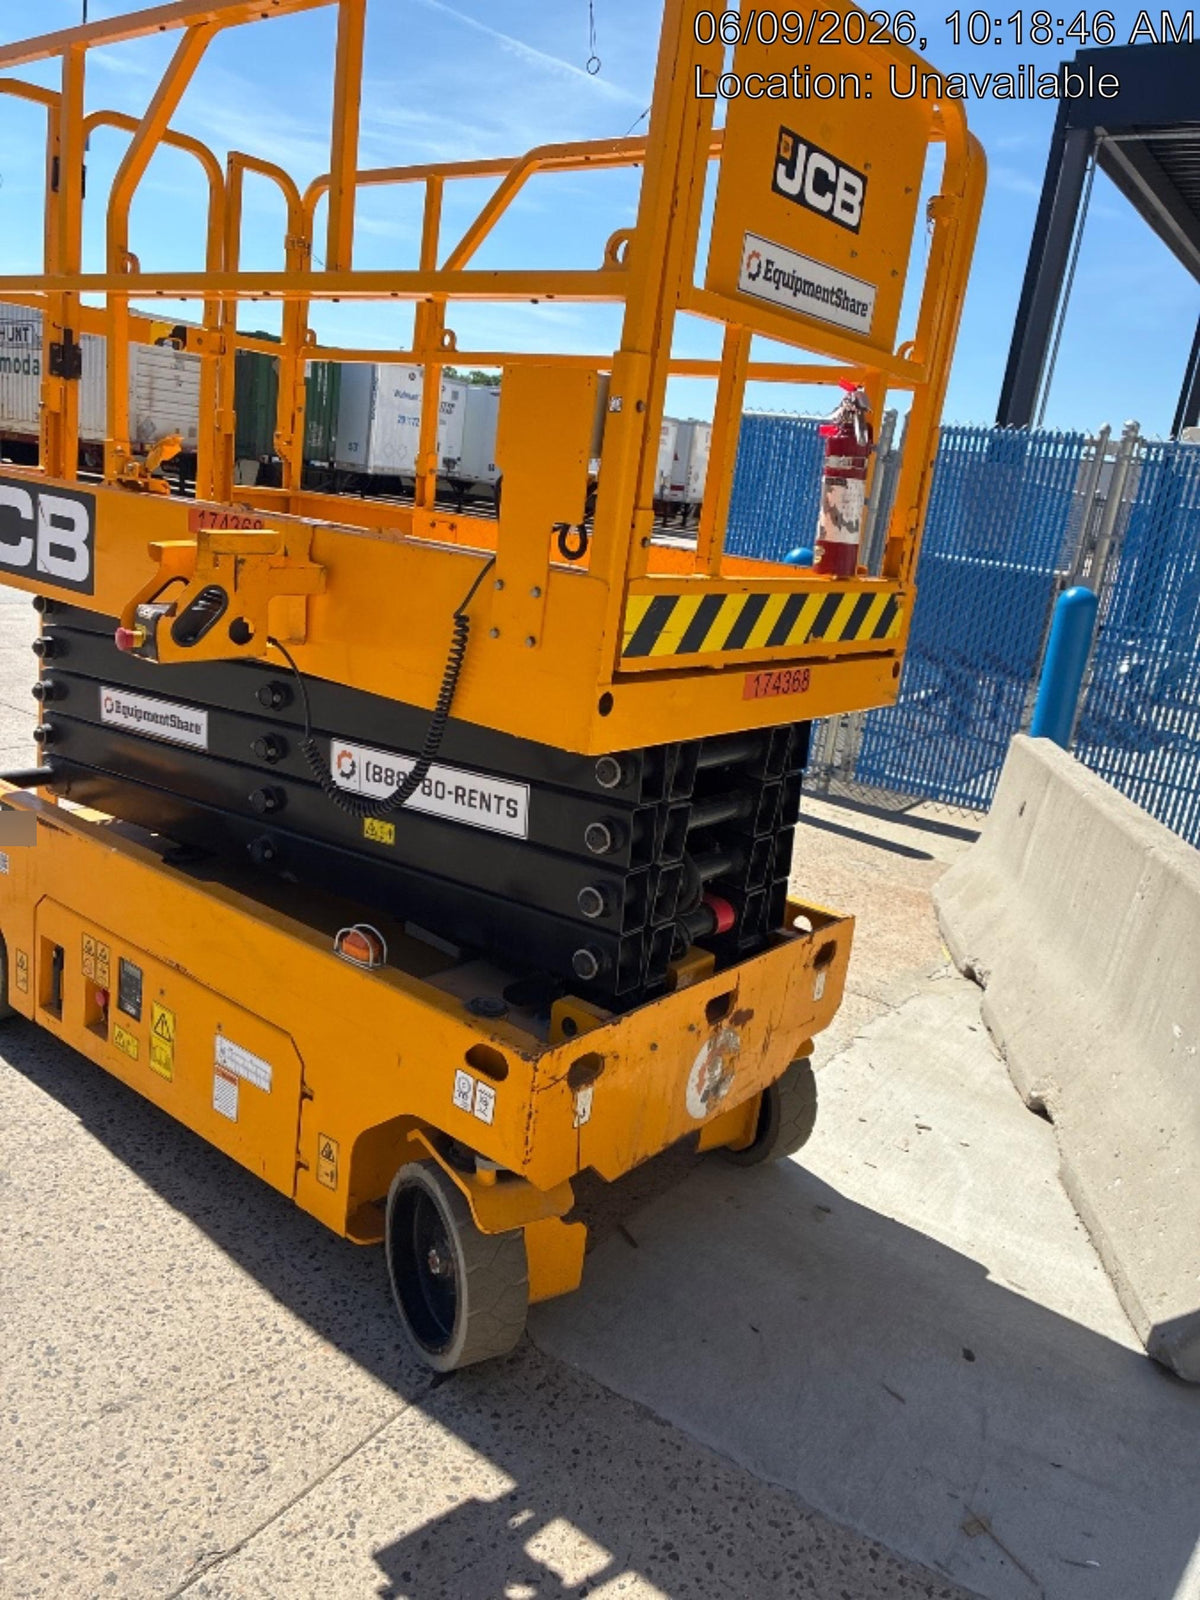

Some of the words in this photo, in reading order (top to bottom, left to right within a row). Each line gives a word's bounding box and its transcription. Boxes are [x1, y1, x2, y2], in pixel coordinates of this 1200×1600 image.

[776, 143, 865, 228] JCB
[762, 258, 869, 318] EquipmentShare
[753, 667, 810, 698] 174368
[115, 700, 201, 735] EquipmentShare
[365, 760, 408, 788] (888
